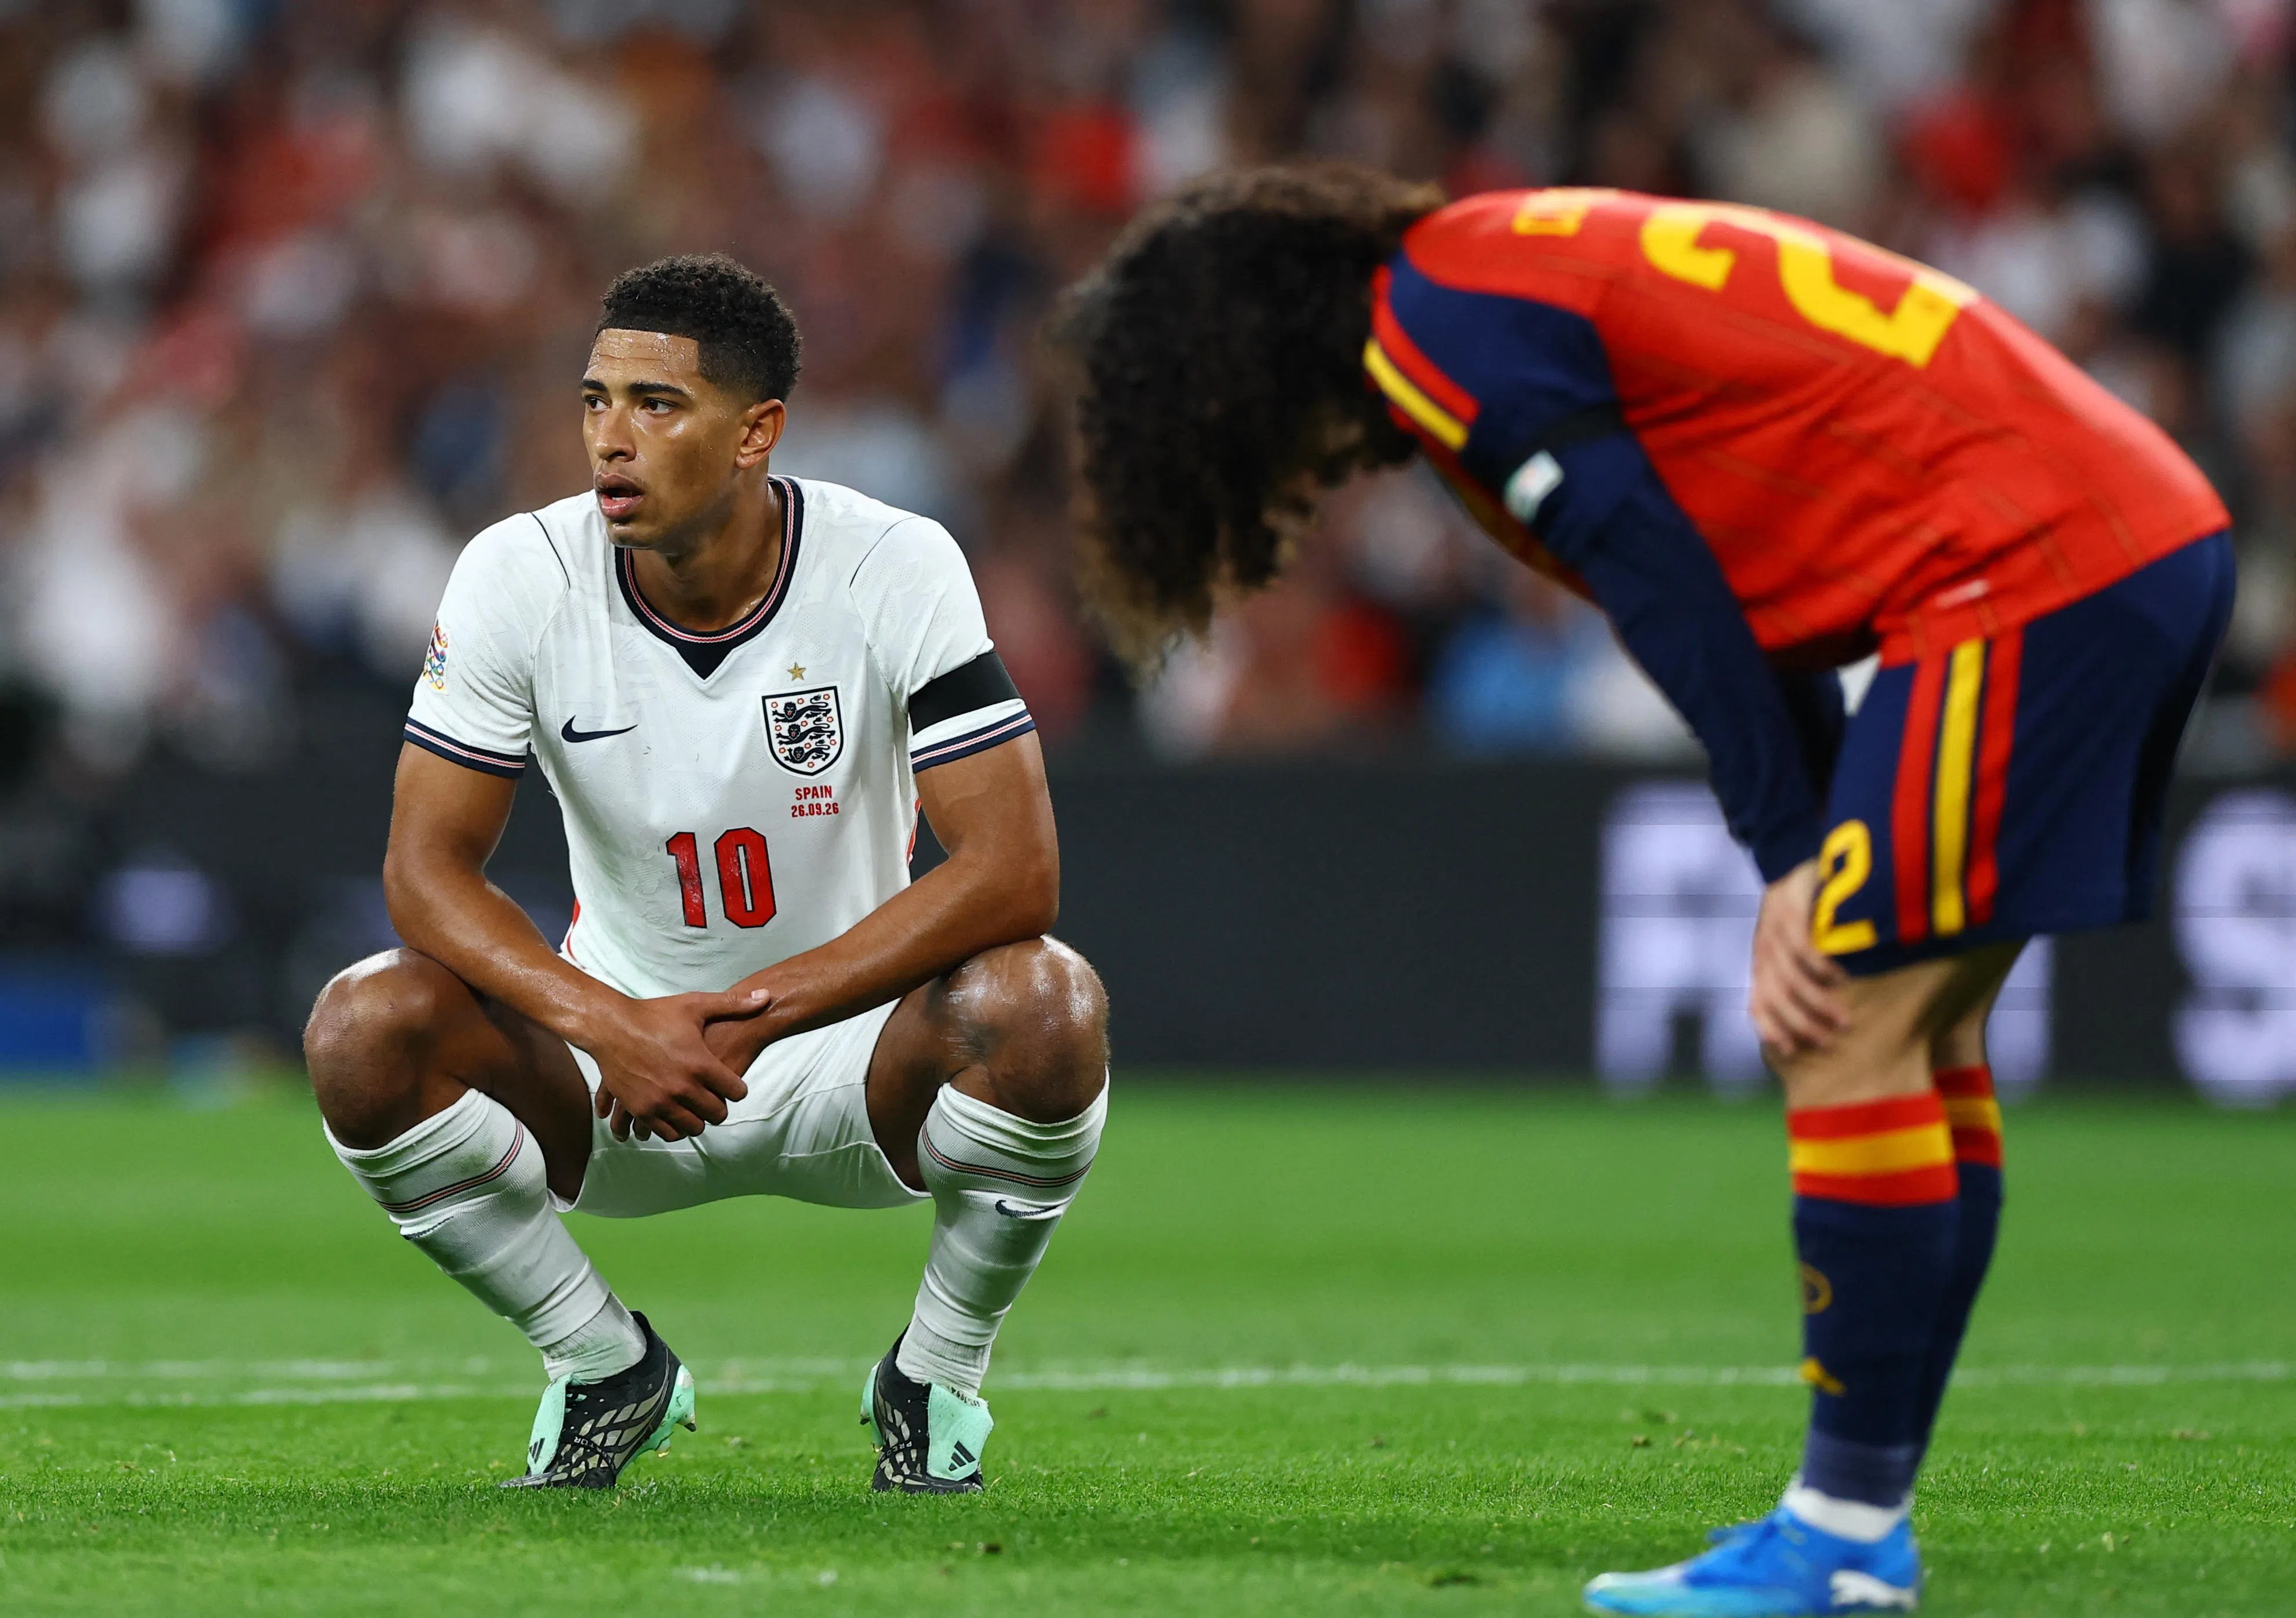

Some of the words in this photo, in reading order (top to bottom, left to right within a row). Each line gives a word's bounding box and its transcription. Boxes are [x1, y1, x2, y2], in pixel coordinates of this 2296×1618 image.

[1640, 203, 1980, 369] 2
[791, 802, 840, 818] 26.09.26
[795, 785, 833, 801] SPAIN
[666, 827, 777, 929] 10
[1813, 819, 1877, 955] 2
